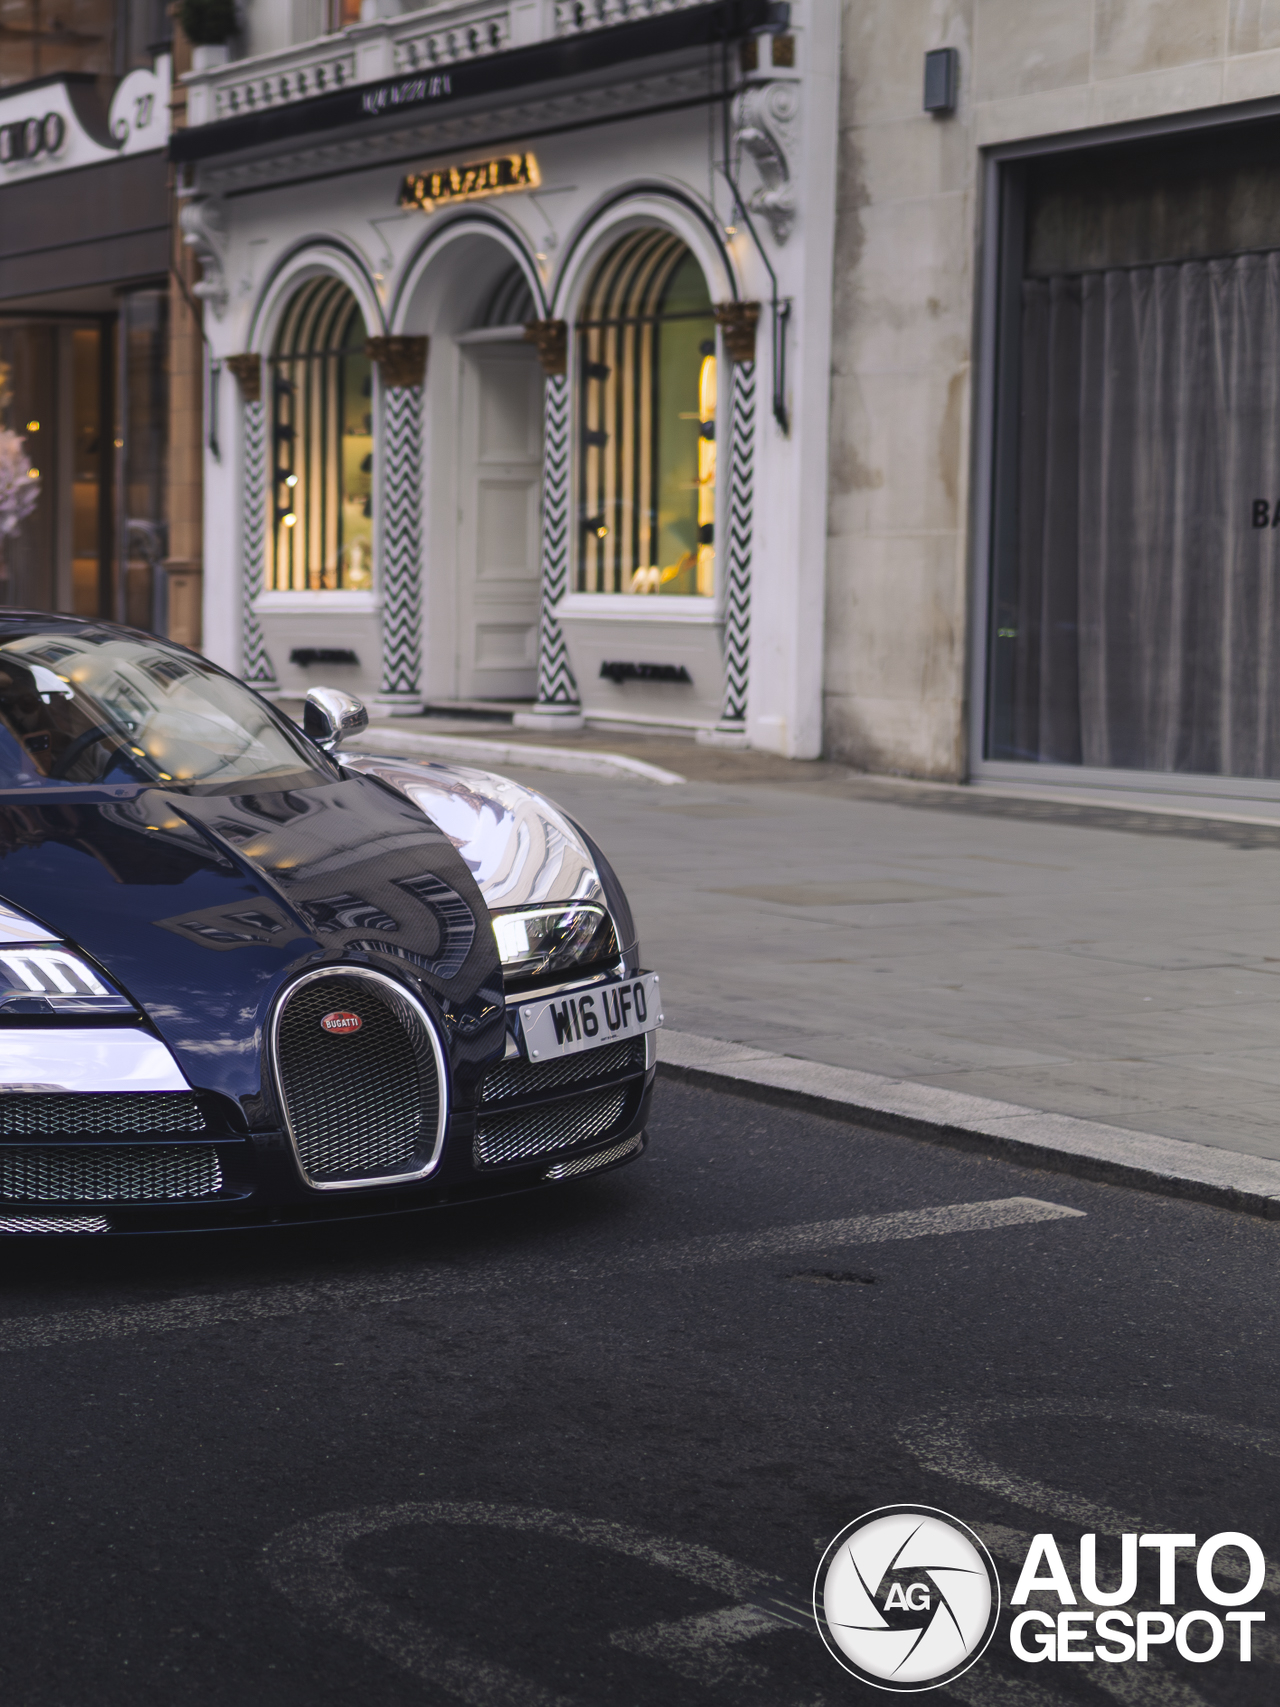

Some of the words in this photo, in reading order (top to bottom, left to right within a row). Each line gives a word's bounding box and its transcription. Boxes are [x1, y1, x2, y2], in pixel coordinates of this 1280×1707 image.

[325, 1017, 359, 1029] BUGATTI
[549, 995, 599, 1046] W16
[601, 981, 648, 1032] UFO
